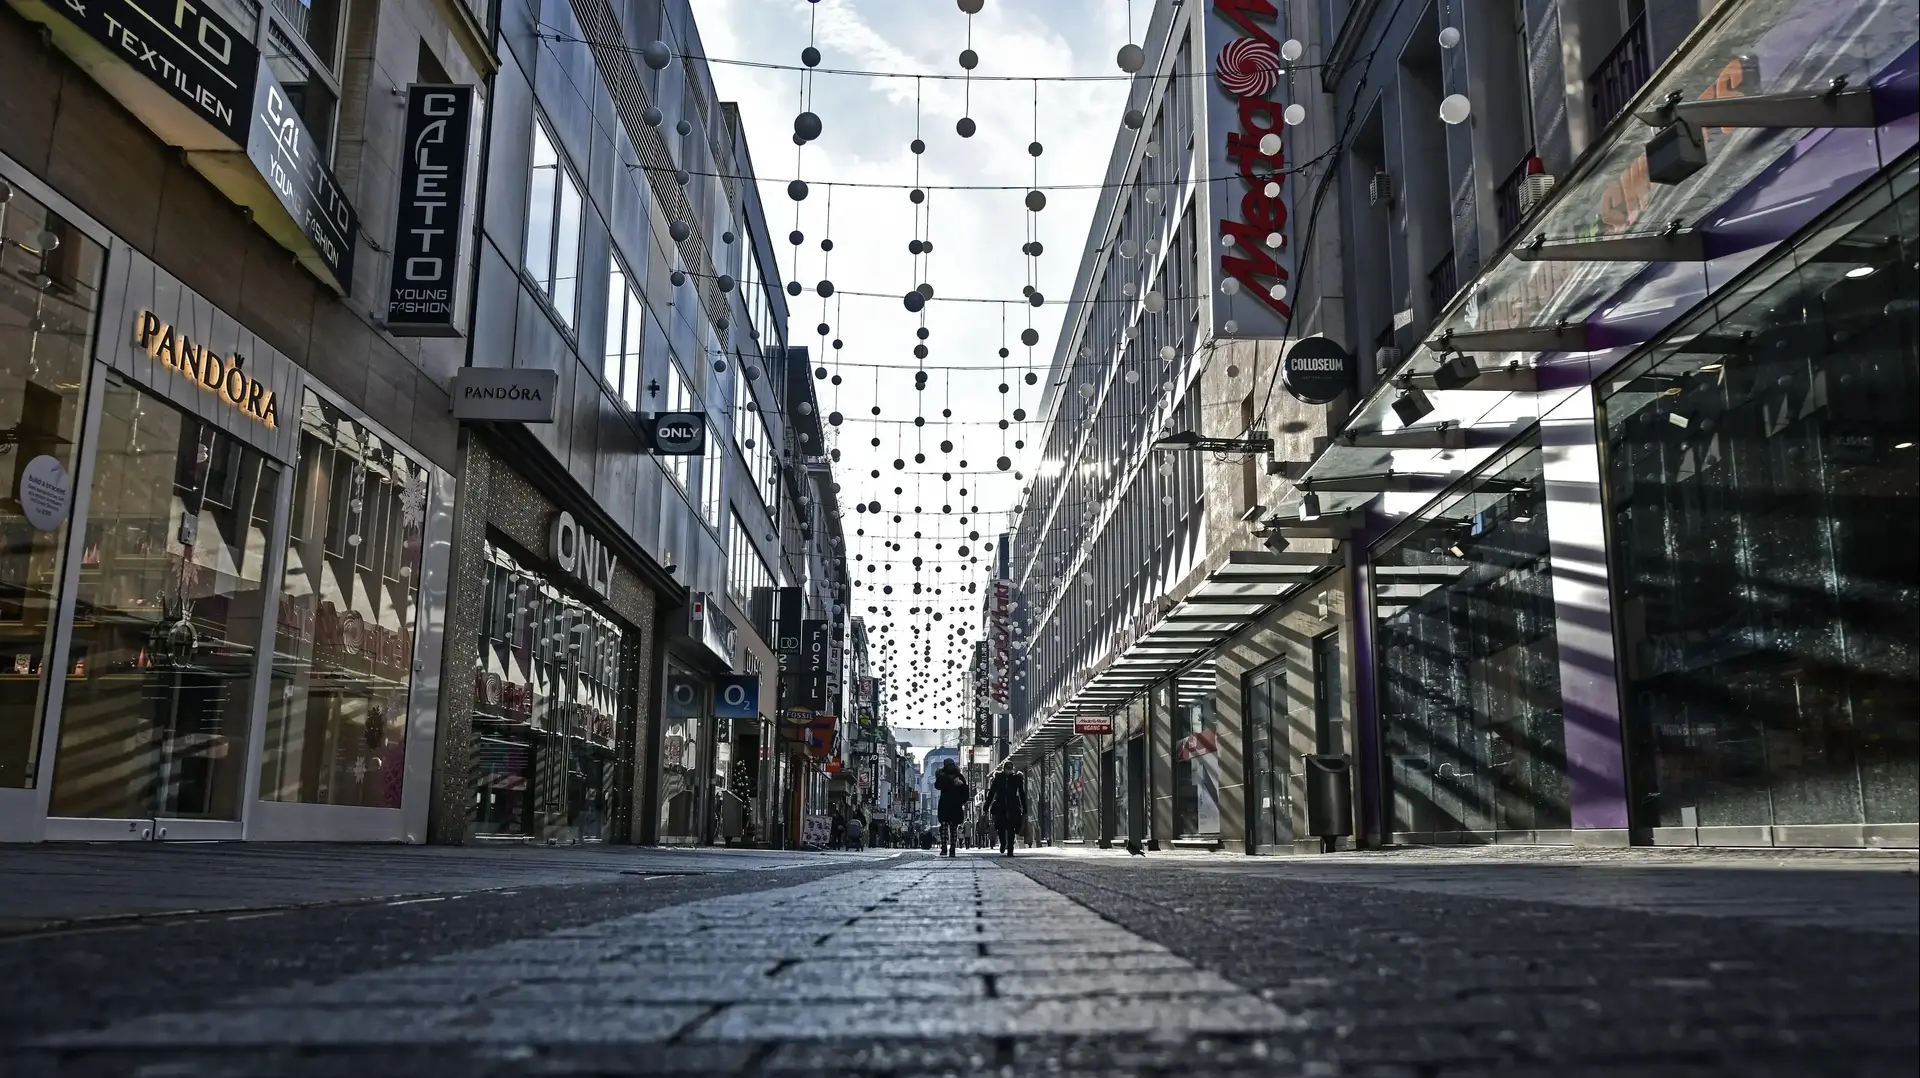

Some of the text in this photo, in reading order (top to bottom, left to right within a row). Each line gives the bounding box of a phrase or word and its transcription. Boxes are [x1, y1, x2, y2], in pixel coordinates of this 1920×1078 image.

[103, 12, 234, 127] TEXTILIEN
[405, 93, 456, 282] CALETTO
[269, 153, 339, 269] YOUNG FASHION
[388, 301, 450, 314] FASHION
[395, 288, 448, 301] YOUNG
[142, 310, 281, 428] PANDORA
[1290, 358, 1344, 371] COLLOSEUM
[464, 384, 542, 401] PANDORA
[658, 428, 700, 440] ONLY
[556, 511, 618, 600] ONLY
[811, 631, 821, 698] FOSSIL
[724, 684, 750, 711] O2
[786, 711, 814, 719] FOSSIL
